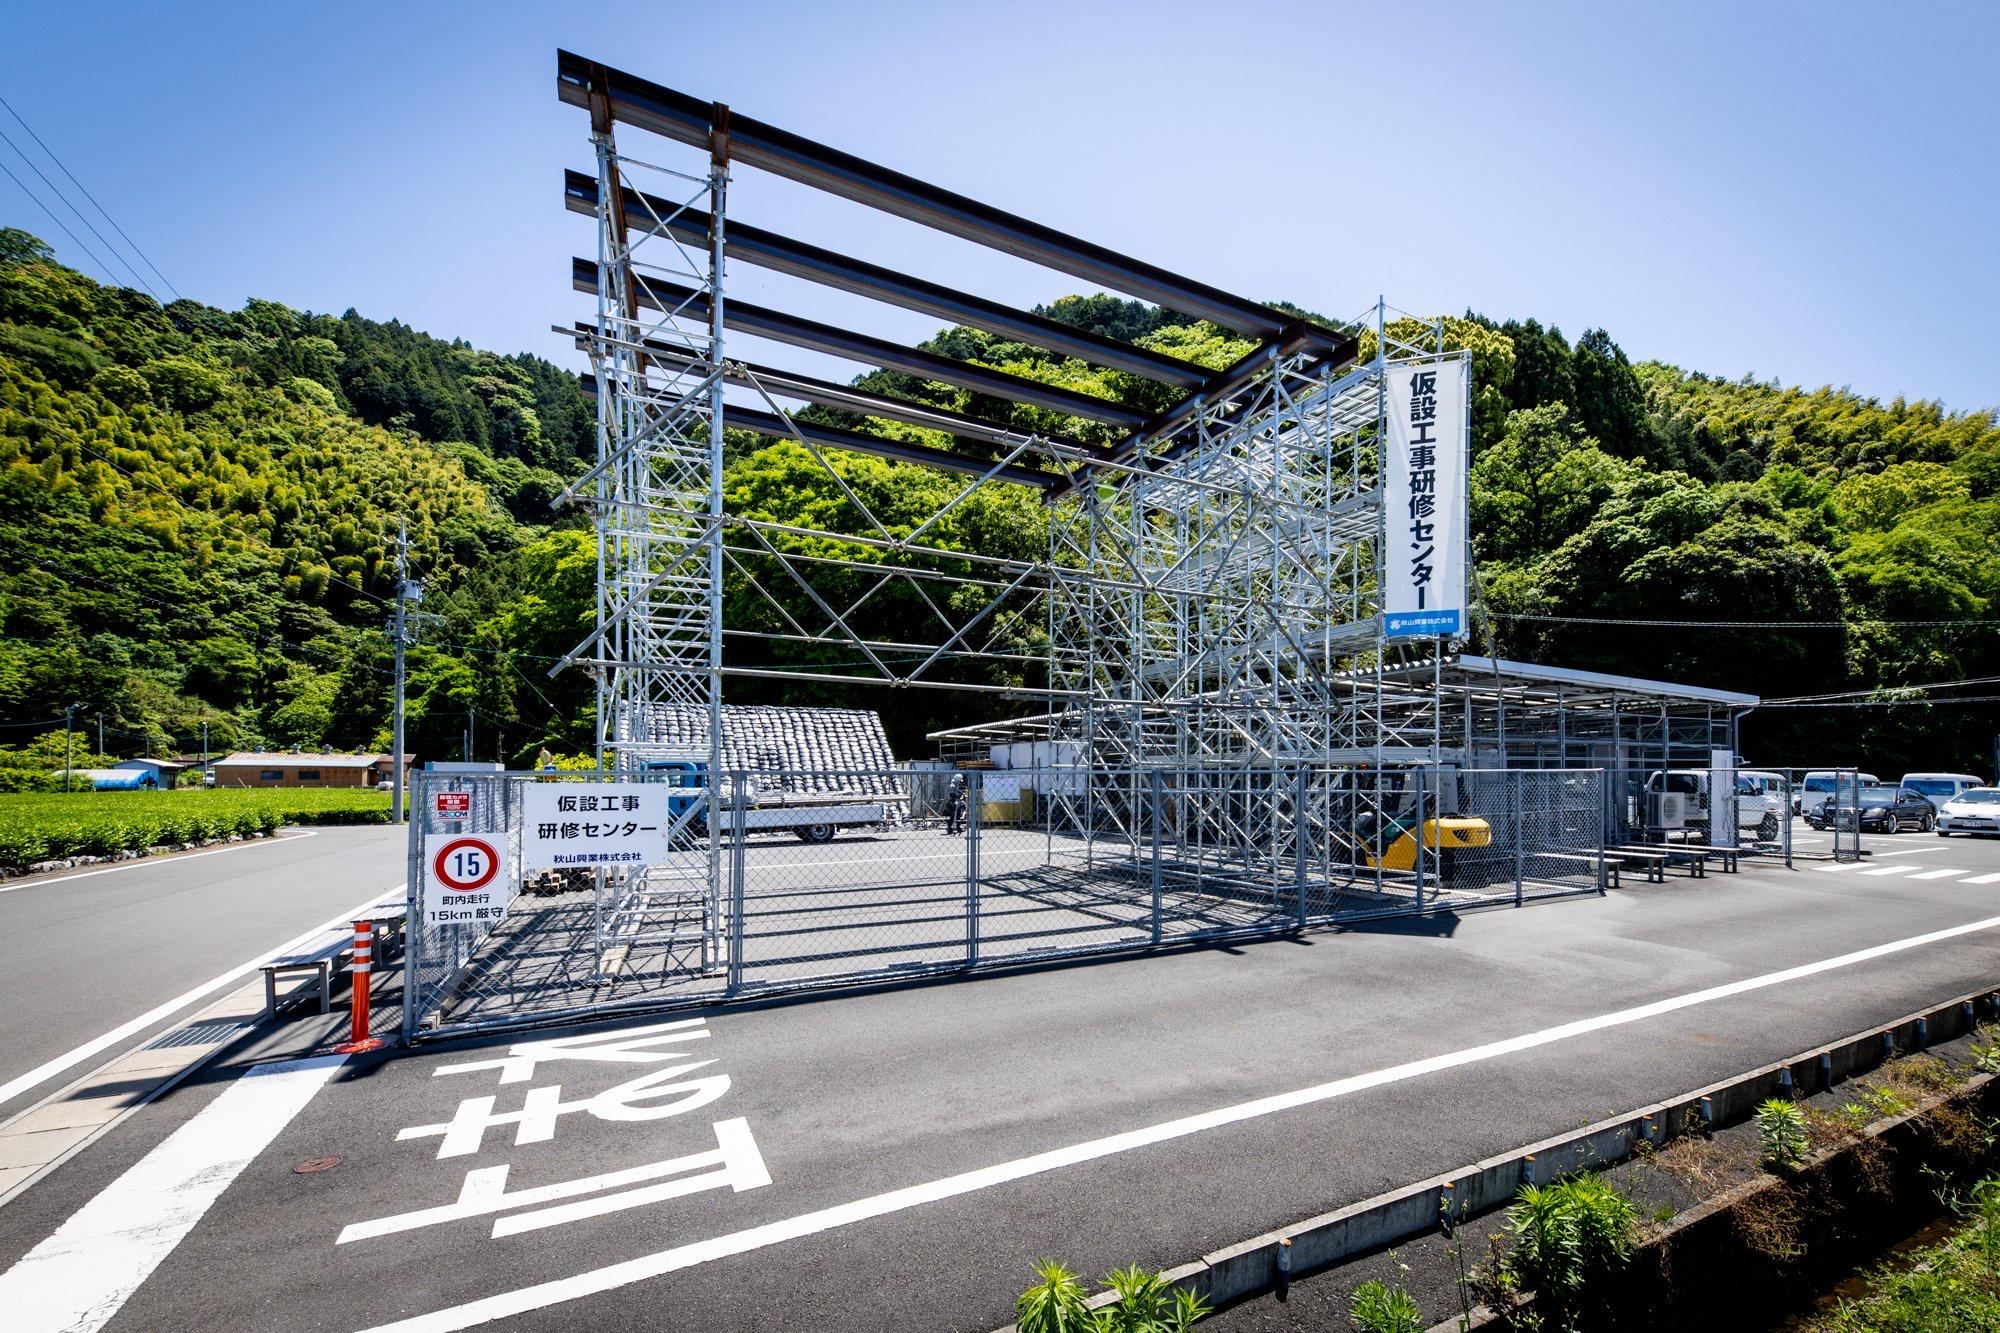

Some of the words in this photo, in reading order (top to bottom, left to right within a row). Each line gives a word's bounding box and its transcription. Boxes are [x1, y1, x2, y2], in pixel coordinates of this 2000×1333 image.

[1409, 371, 1437, 610] 仮設工事研修センター
[557, 795, 640, 813] 仮設工事
[538, 821, 657, 840] 研修センター
[454, 852, 480, 877] 15
[442, 893, 490, 906] 町内走行
[430, 910, 472, 922] 15km
[475, 907, 504, 919] 厳守
[335, 1017, 774, 1245] 止まれ
